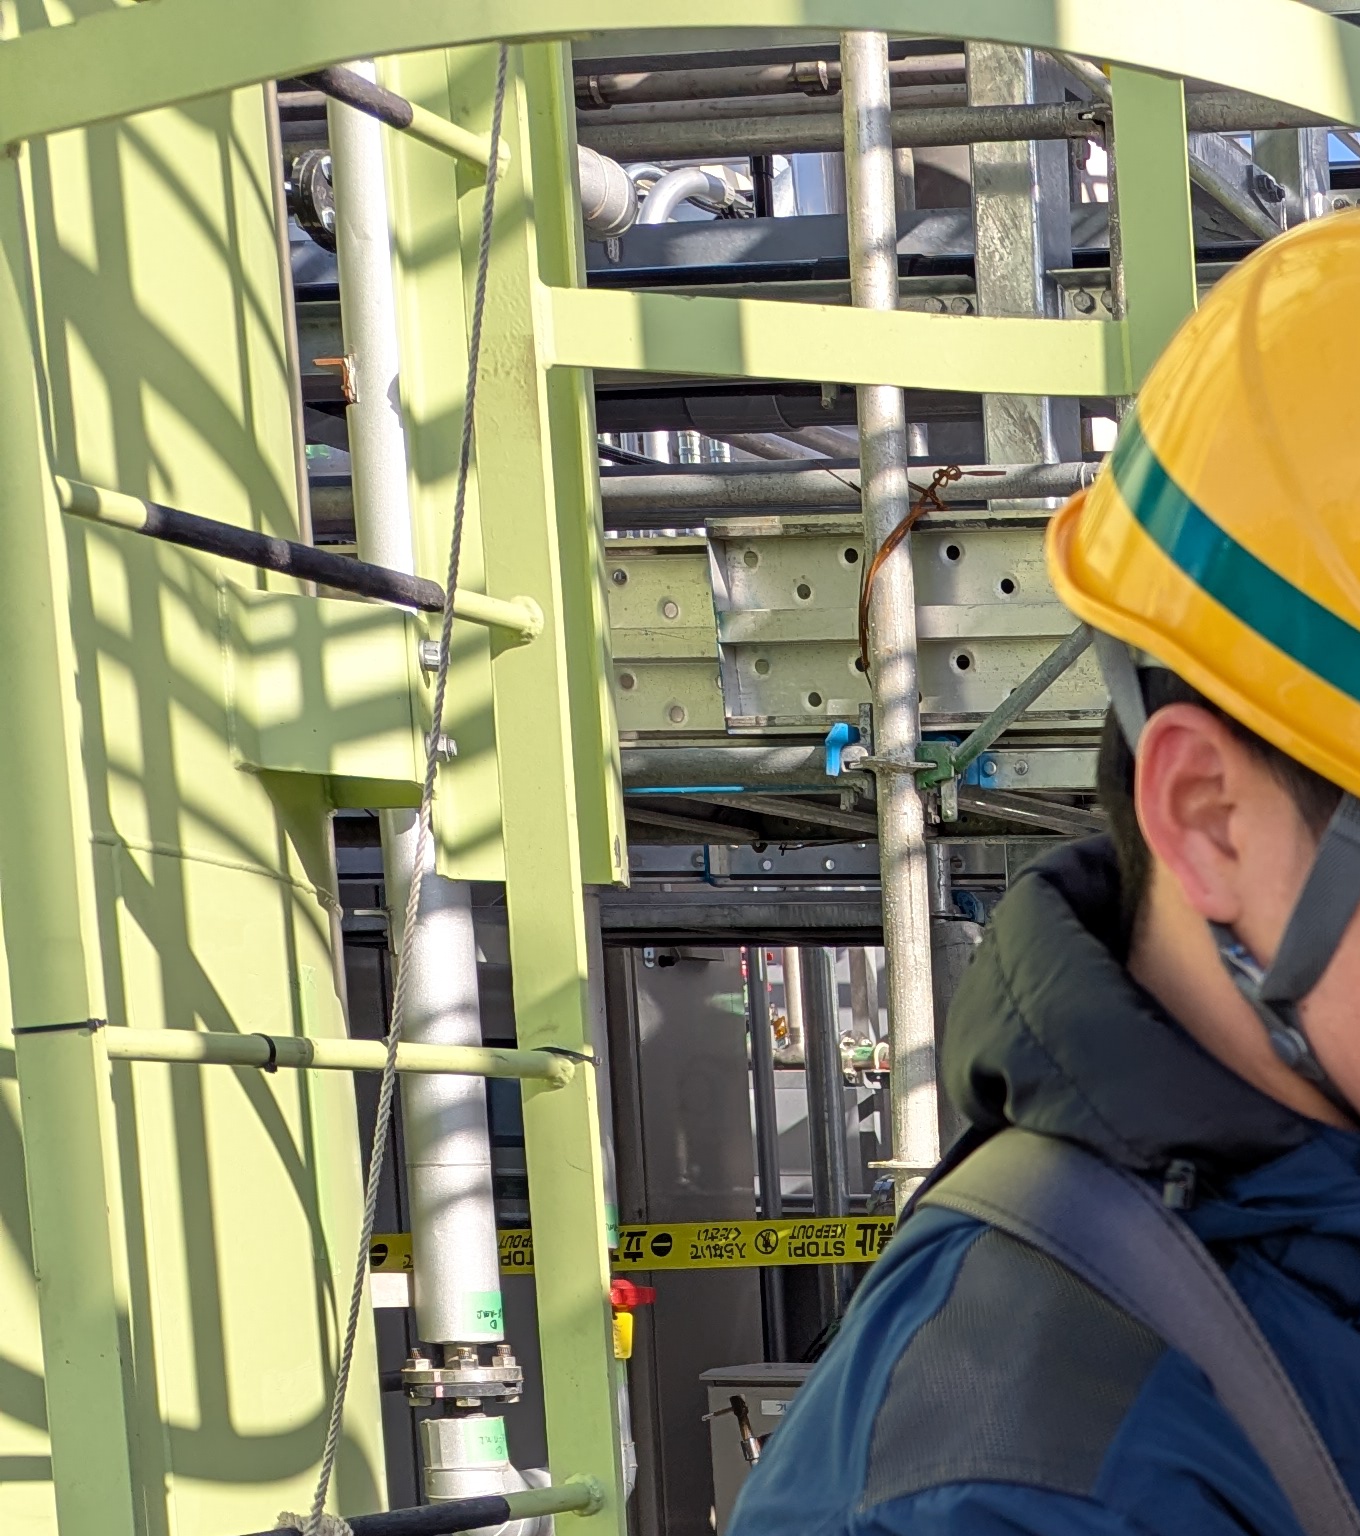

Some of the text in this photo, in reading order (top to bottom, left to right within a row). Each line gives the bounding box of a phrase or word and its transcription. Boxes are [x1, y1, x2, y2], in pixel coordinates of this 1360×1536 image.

[789, 1224, 848, 1240] KEEP OUT
[788, 1241, 846, 1258] STOP!
